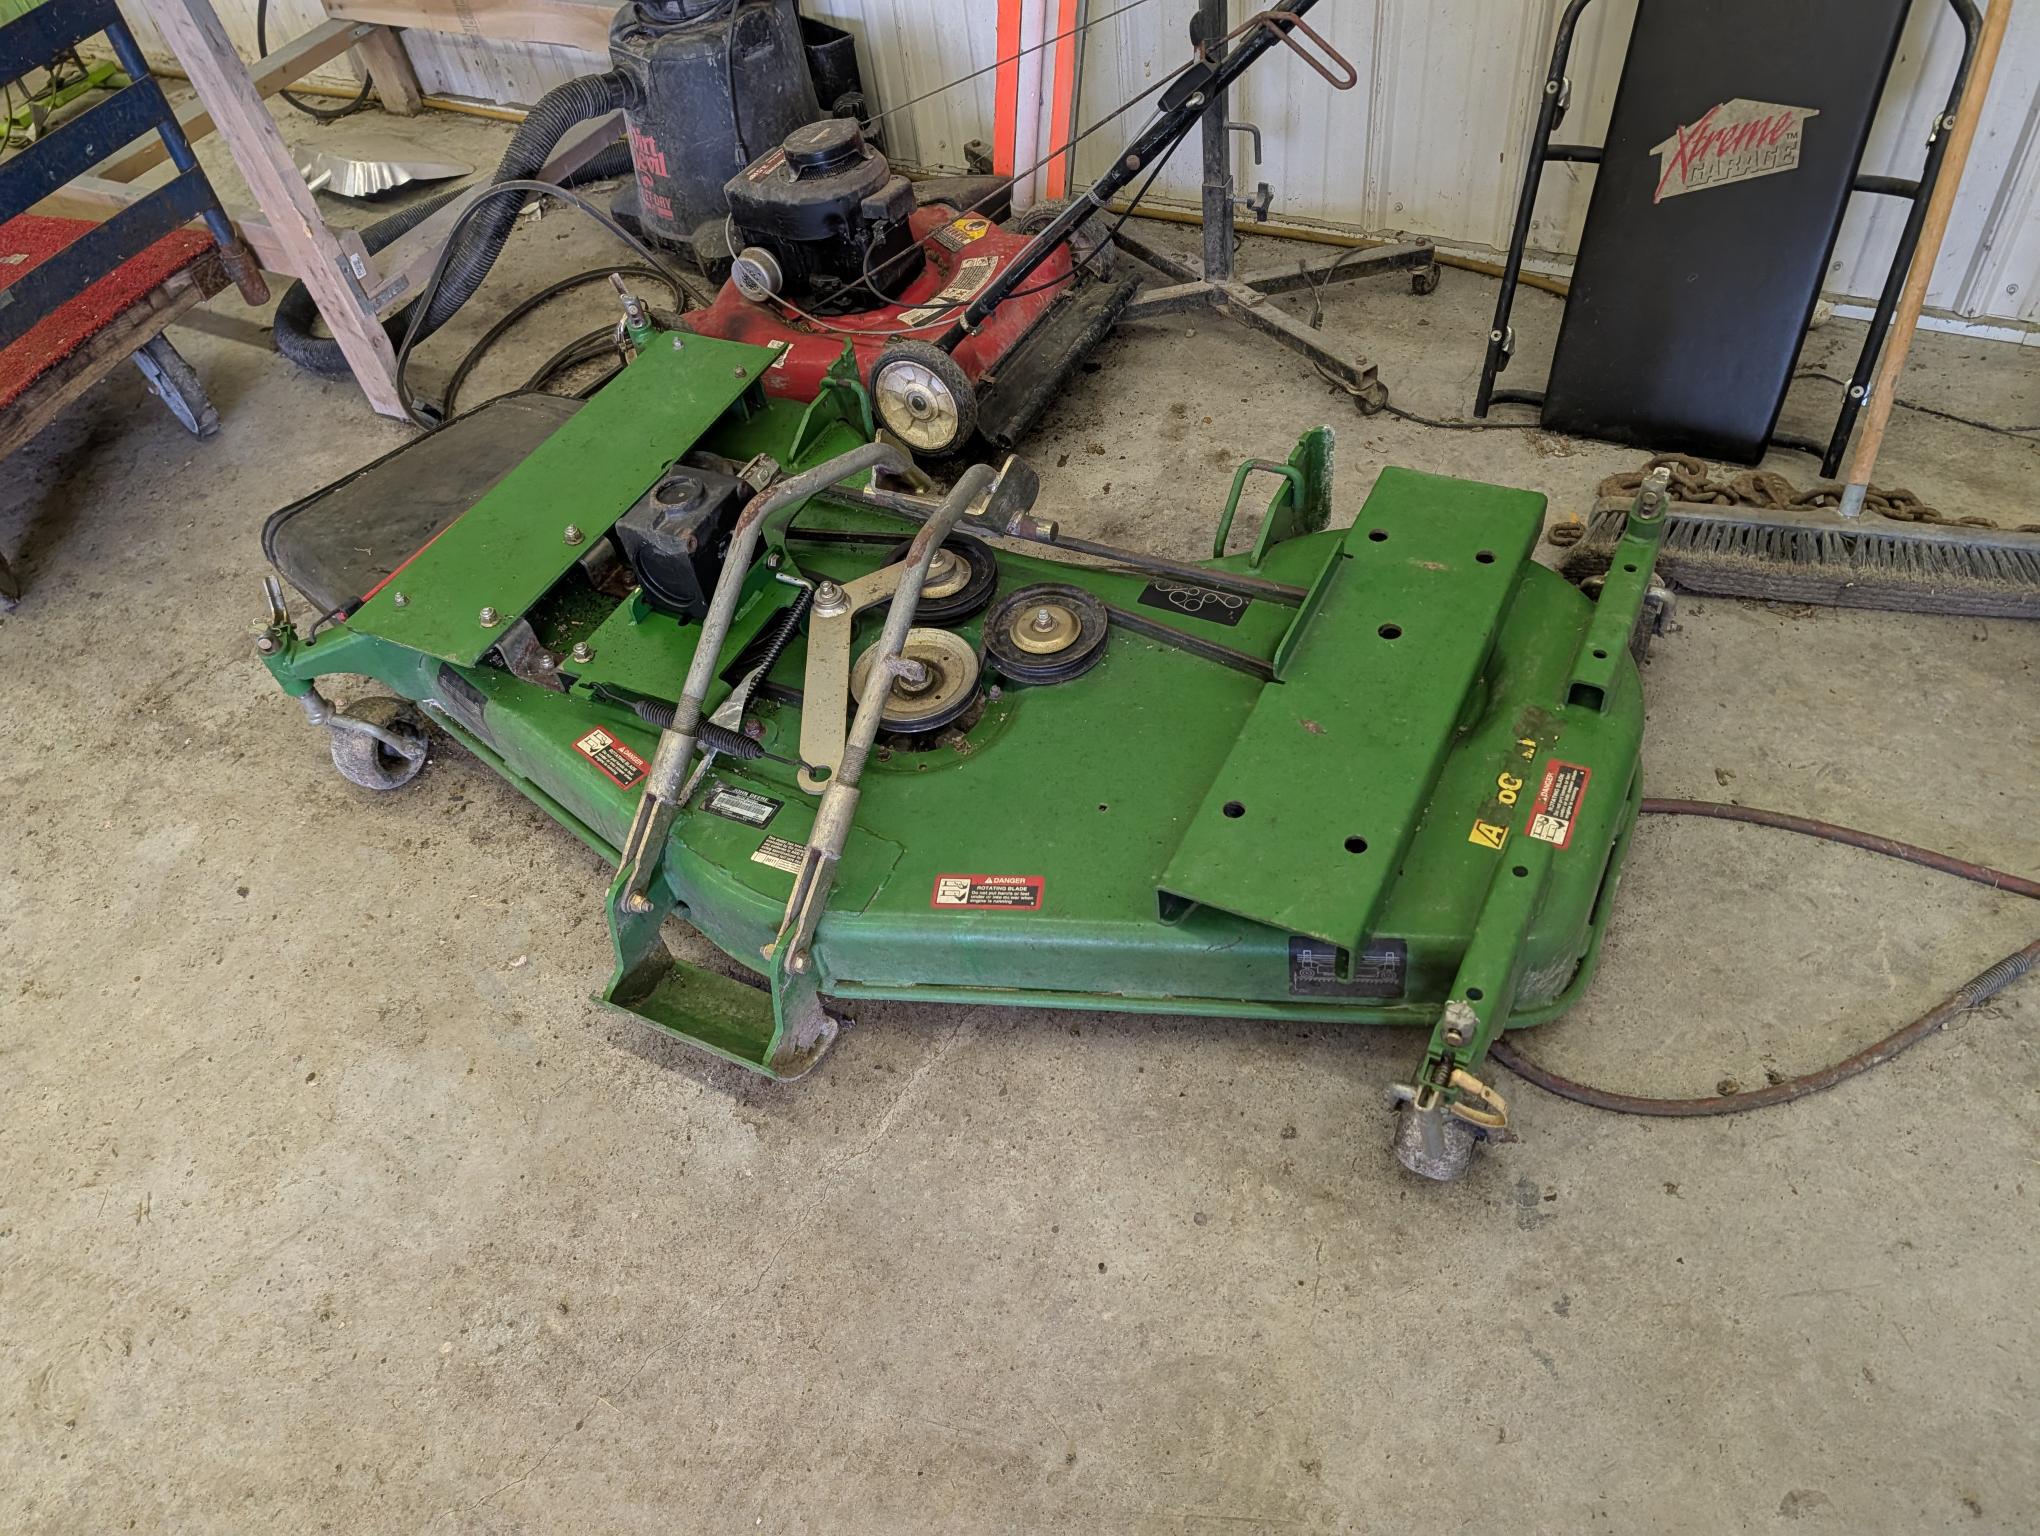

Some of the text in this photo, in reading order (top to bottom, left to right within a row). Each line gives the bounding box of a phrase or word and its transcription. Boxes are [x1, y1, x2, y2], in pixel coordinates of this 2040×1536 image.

[1653, 103, 1796, 204] Xtreme
[1686, 141, 1798, 188] GARAGE
[749, 793, 770, 802] DEERE
